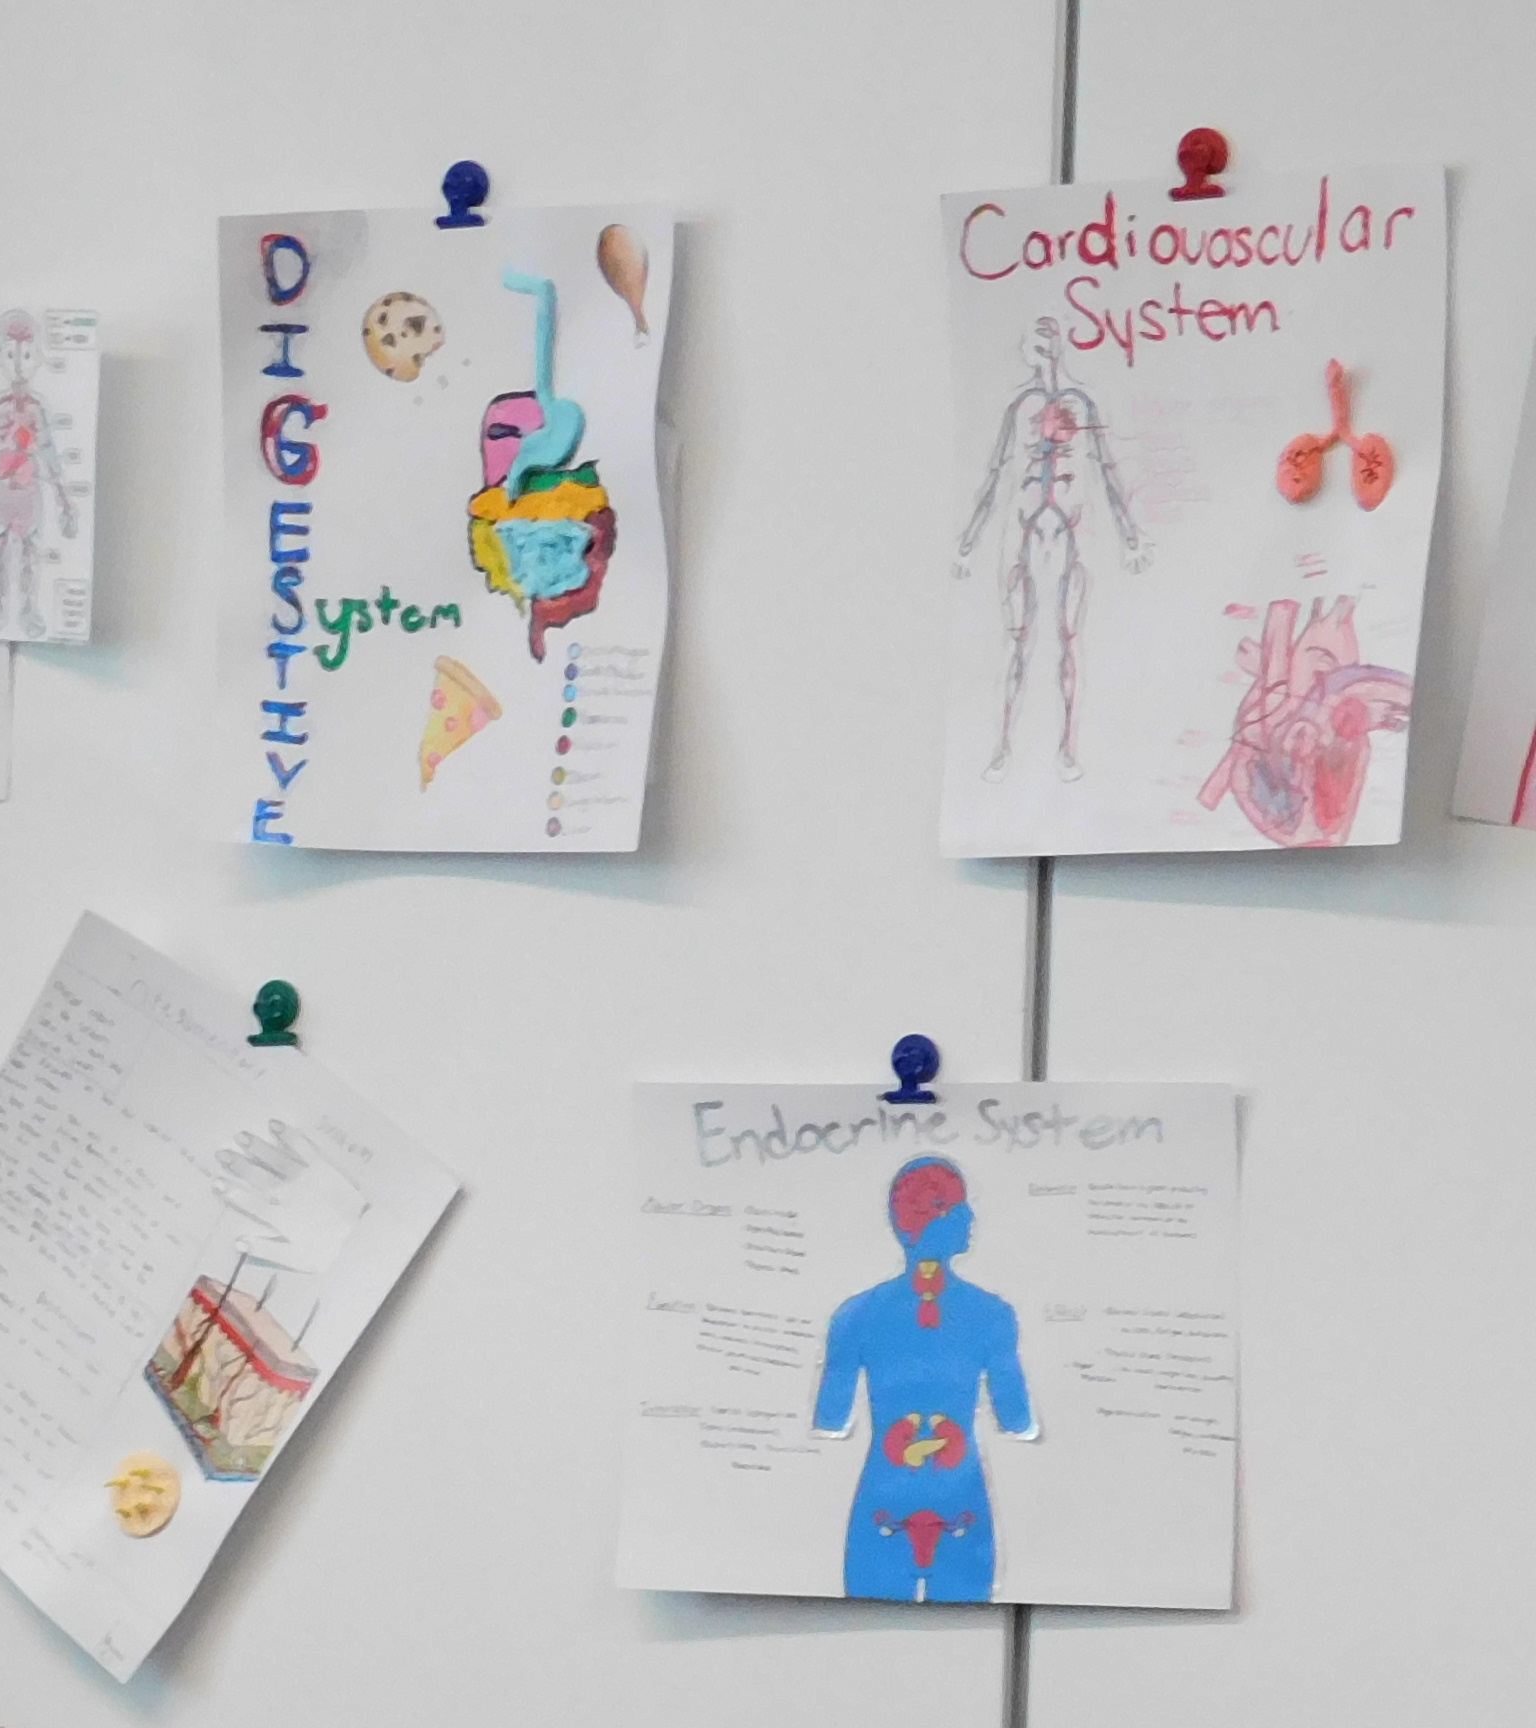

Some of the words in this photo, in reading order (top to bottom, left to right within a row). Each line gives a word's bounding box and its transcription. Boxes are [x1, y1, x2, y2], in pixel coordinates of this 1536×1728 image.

[959, 176, 1415, 279] Cardiovascular
[1065, 275, 1281, 367] System
[692, 1099, 960, 1169] Endocrine
[973, 1097, 1165, 1151] System
